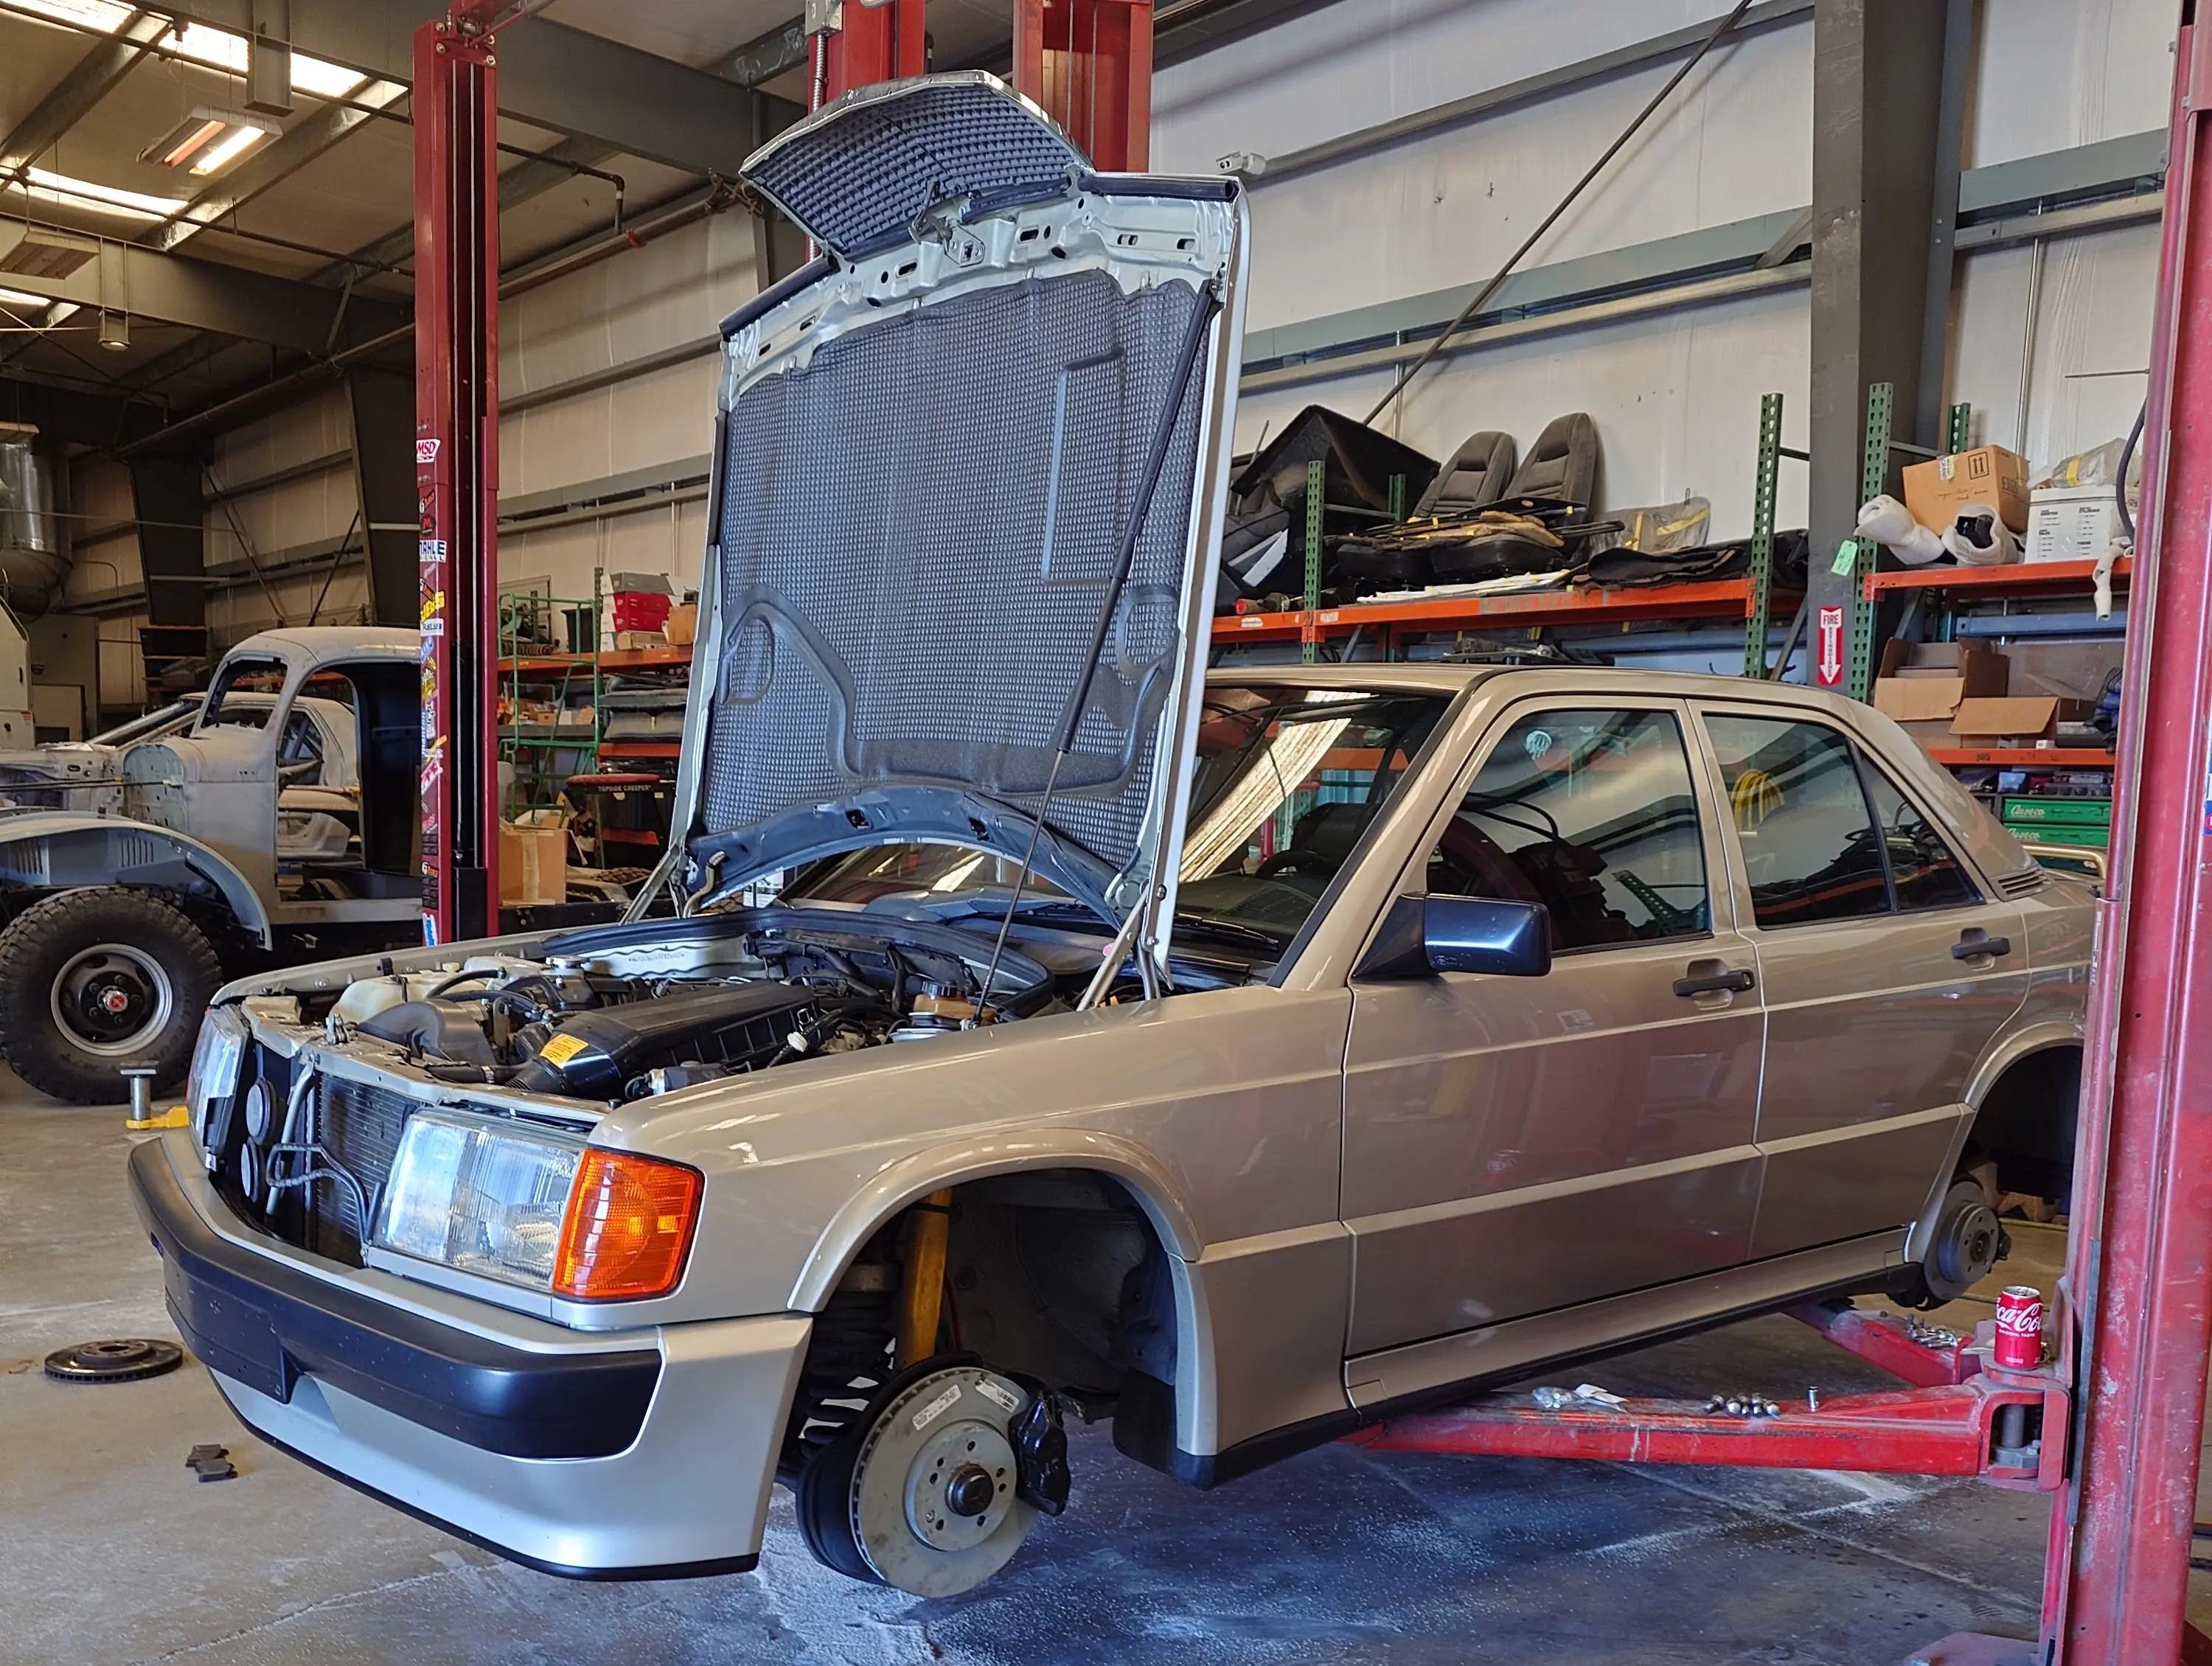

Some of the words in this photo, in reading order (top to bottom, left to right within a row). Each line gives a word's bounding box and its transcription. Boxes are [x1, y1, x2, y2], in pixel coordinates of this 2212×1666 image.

[417, 441, 436, 454] MSD
[1823, 614, 1839, 624] FIRE
[1996, 1297, 2043, 1332] ca-Col
[1998, 1328, 2020, 1337] ORIGINAL
